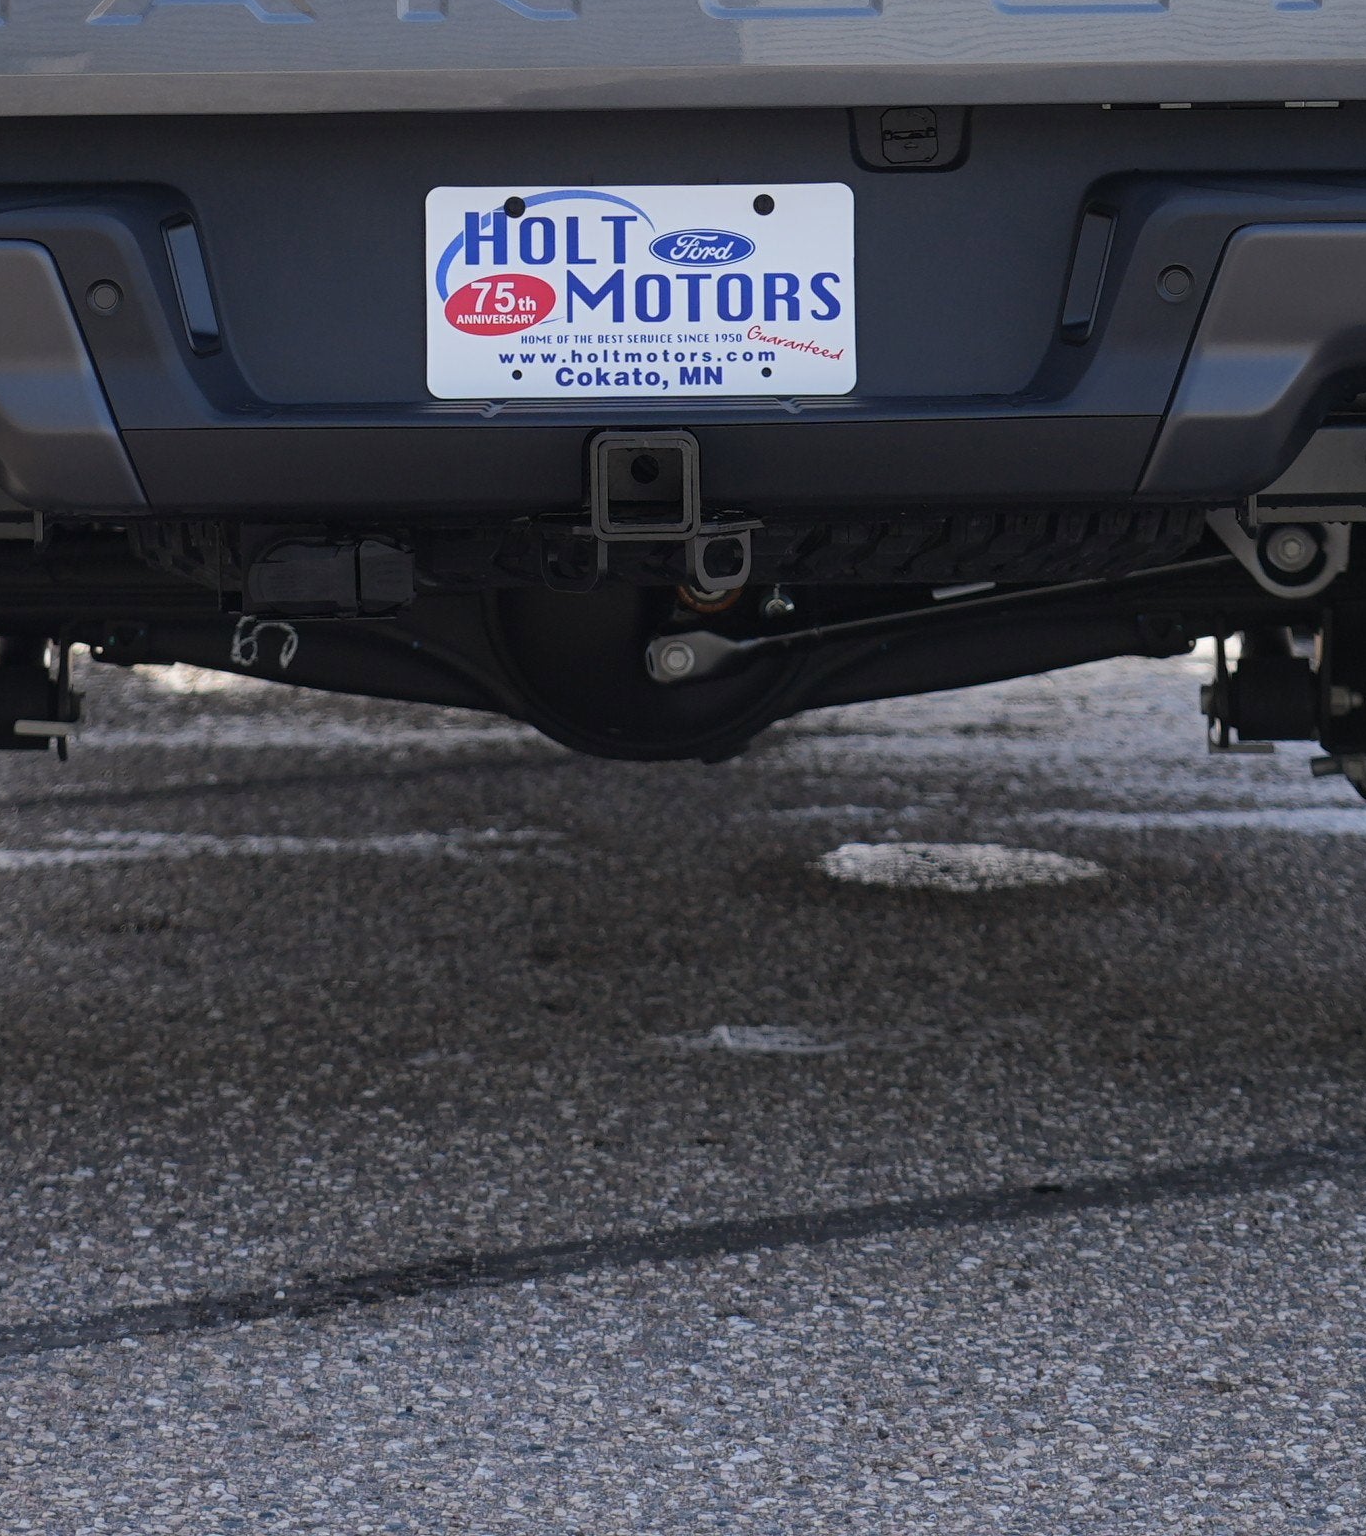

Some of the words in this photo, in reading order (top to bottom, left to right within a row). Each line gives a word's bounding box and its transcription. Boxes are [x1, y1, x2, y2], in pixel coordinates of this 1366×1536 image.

[464, 211, 638, 265] HOLT
[669, 234, 733, 261] Ford
[470, 282, 537, 313] 75th
[567, 269, 841, 323] MOTORS
[456, 313, 536, 326] ANNIVERSARY
[521, 335, 553, 344] HOME
[557, 334, 569, 344] OF
[573, 334, 592, 344] THE
[597, 334, 623, 344] BEST
[627, 334, 673, 344] SERVICE
[677, 333, 710, 343] SINCE
[715, 333, 742, 342] 1950
[746, 325, 845, 361] Guaranteed
[499, 348, 777, 364] www.holtmotors.com
[555, 367, 669, 390] Cokato,
[680, 366, 723, 385] MN
